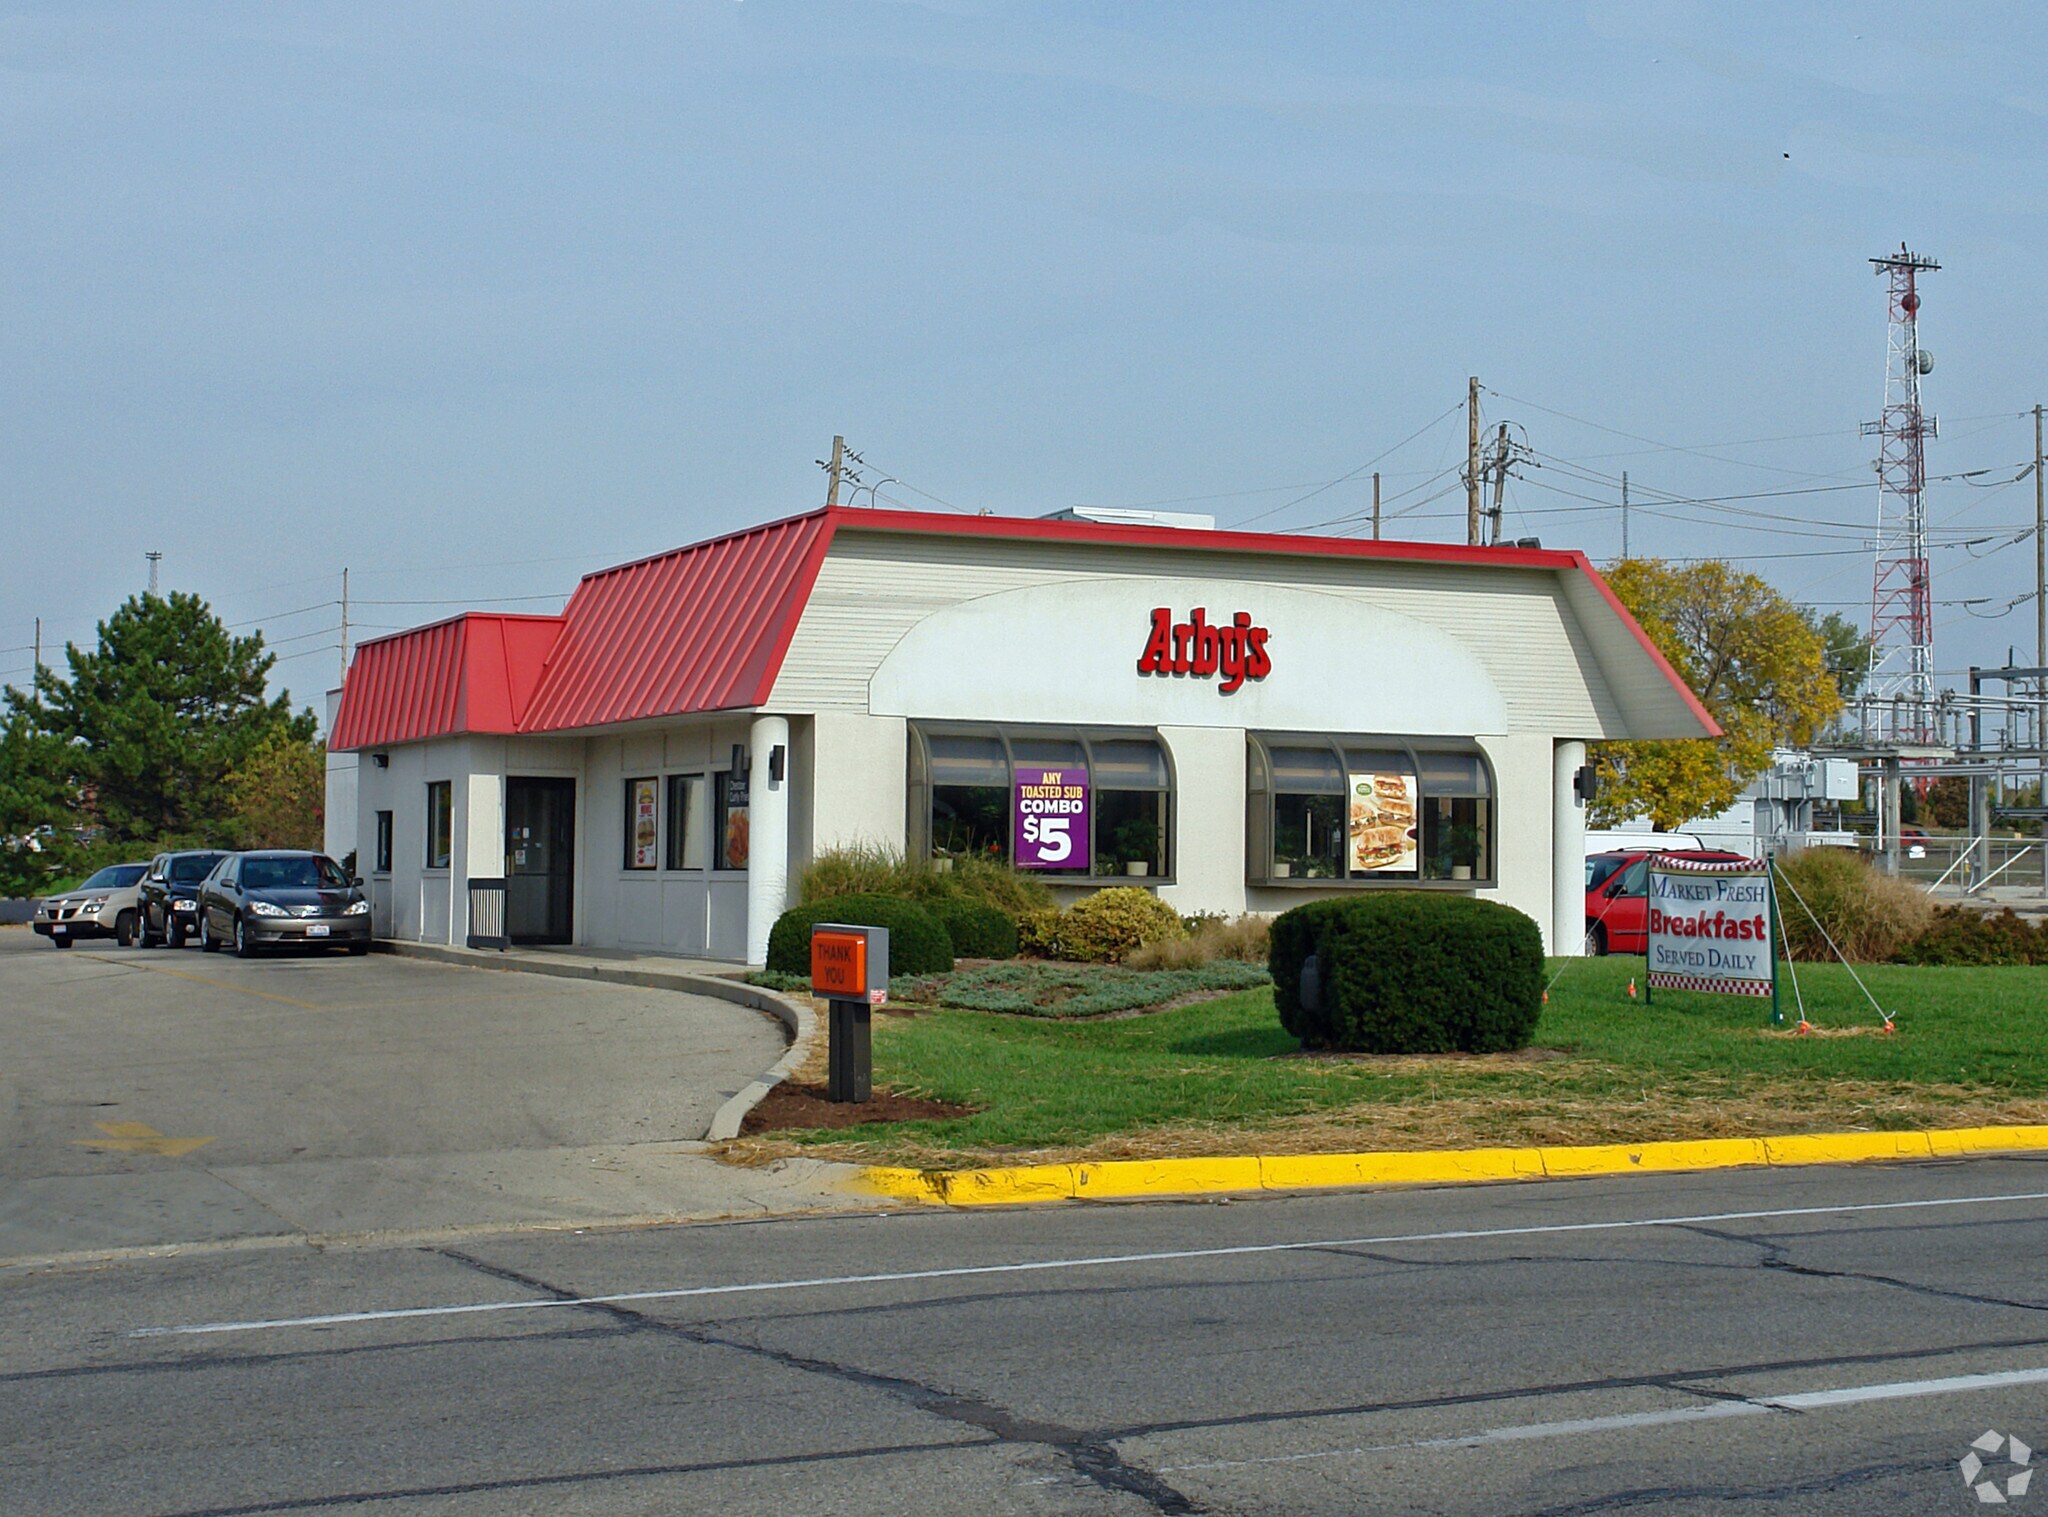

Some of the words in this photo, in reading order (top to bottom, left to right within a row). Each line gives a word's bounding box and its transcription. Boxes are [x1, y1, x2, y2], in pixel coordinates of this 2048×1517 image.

[1137, 607, 1271, 696] Arby's
[1042, 772, 1062, 784] ANY
[1021, 786, 1062, 798] TOASTED
[1064, 786, 1082, 798] SUB
[1020, 800, 1083, 813] COMBO
[1023, 815, 1072, 861] $5
[1651, 909, 1766, 940] Breakfast
[818, 944, 851, 963] THANK
[825, 966, 844, 984] YOU
